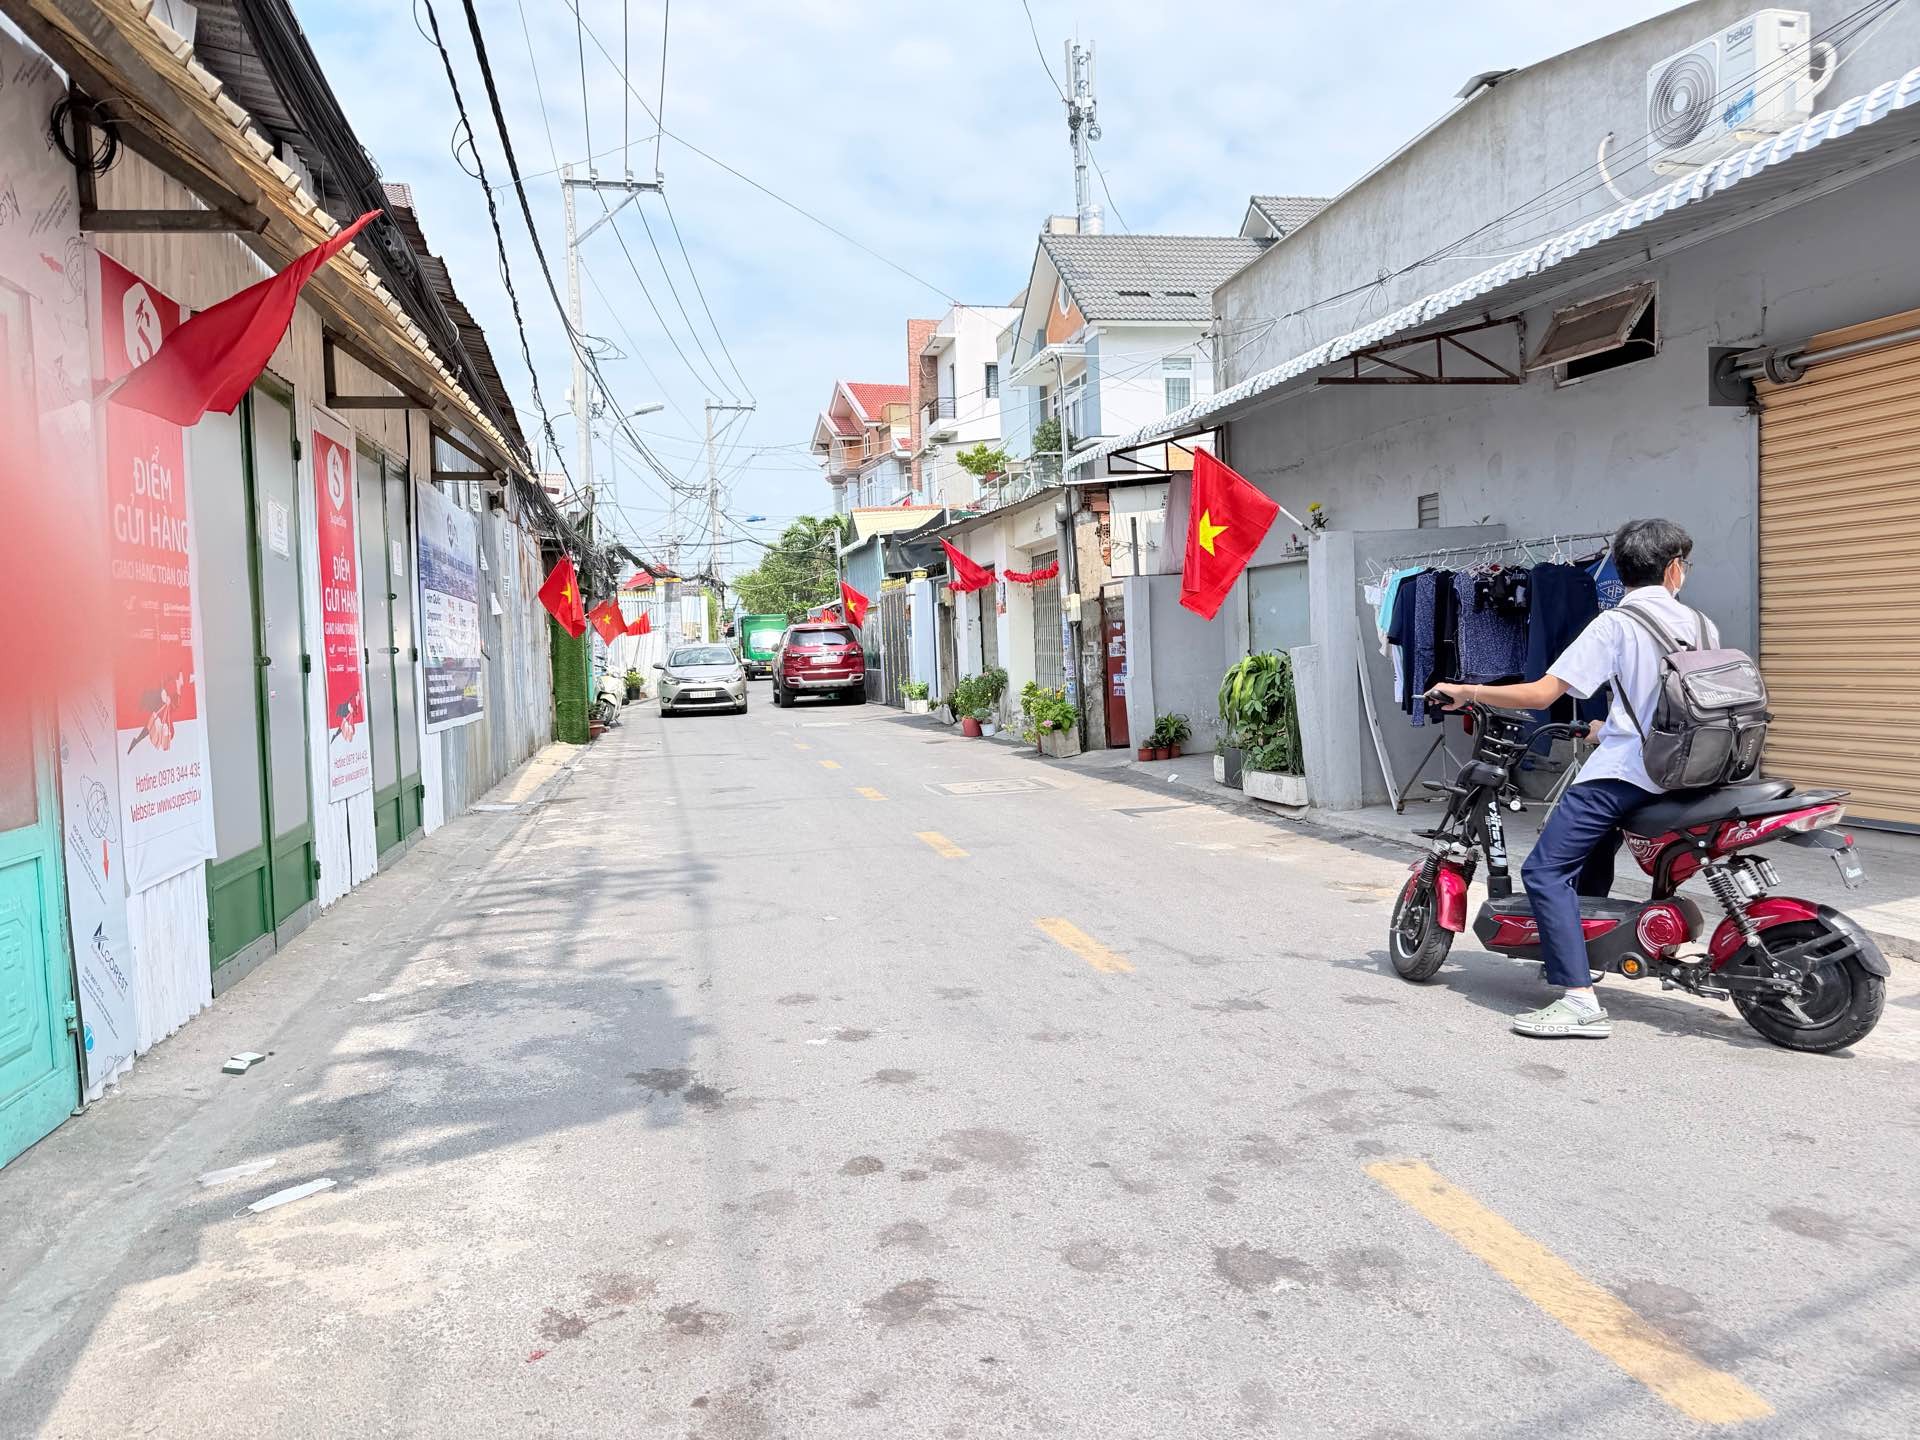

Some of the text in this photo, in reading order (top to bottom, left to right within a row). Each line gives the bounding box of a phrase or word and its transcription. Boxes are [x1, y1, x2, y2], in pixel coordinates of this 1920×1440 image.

[1726, 25, 1752, 45] beko
[133, 445, 172, 504] ĐIỂM
[114, 492, 145, 547] GỬI
[333, 546, 351, 582] ĐIỂM
[177, 565, 190, 589] QUỐ
[1607, 585, 1622, 598] HP
[159, 767, 175, 788] 0978
[176, 764, 188, 782] 344
[156, 785, 202, 815] www.supership.v
[1533, 1024, 1570, 1033] crocs
